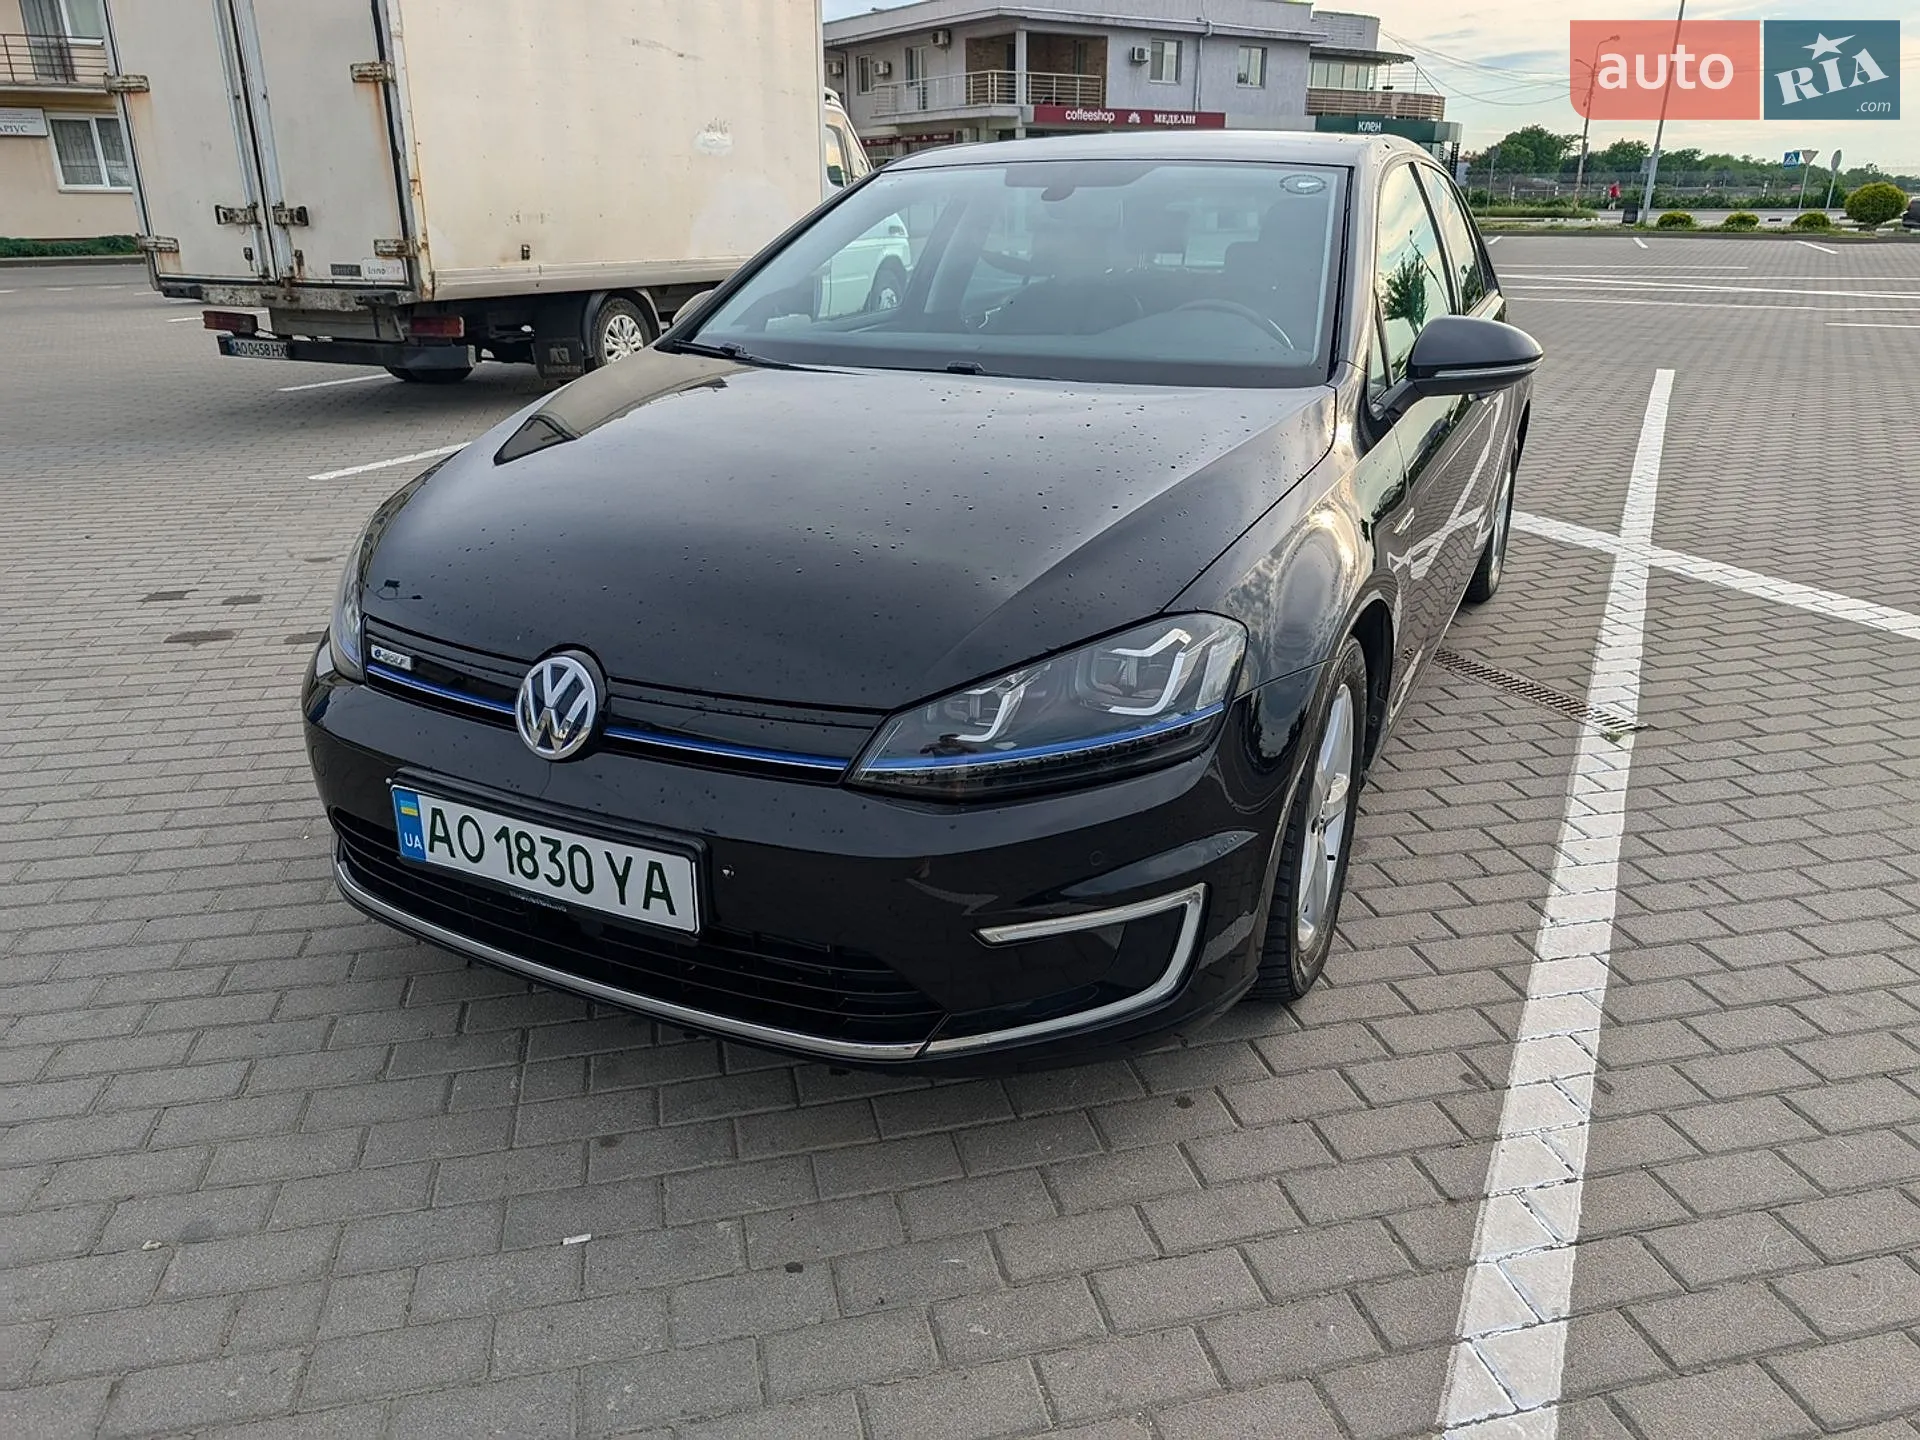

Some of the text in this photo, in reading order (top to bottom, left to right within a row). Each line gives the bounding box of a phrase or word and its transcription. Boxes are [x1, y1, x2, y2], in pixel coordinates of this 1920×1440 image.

[1065, 109, 1116, 124] coffeeshop
[234, 341, 288, 357] AO 0458 HX
[404, 832, 423, 850] UA
[428, 807, 677, 916] AO 1830 YA
